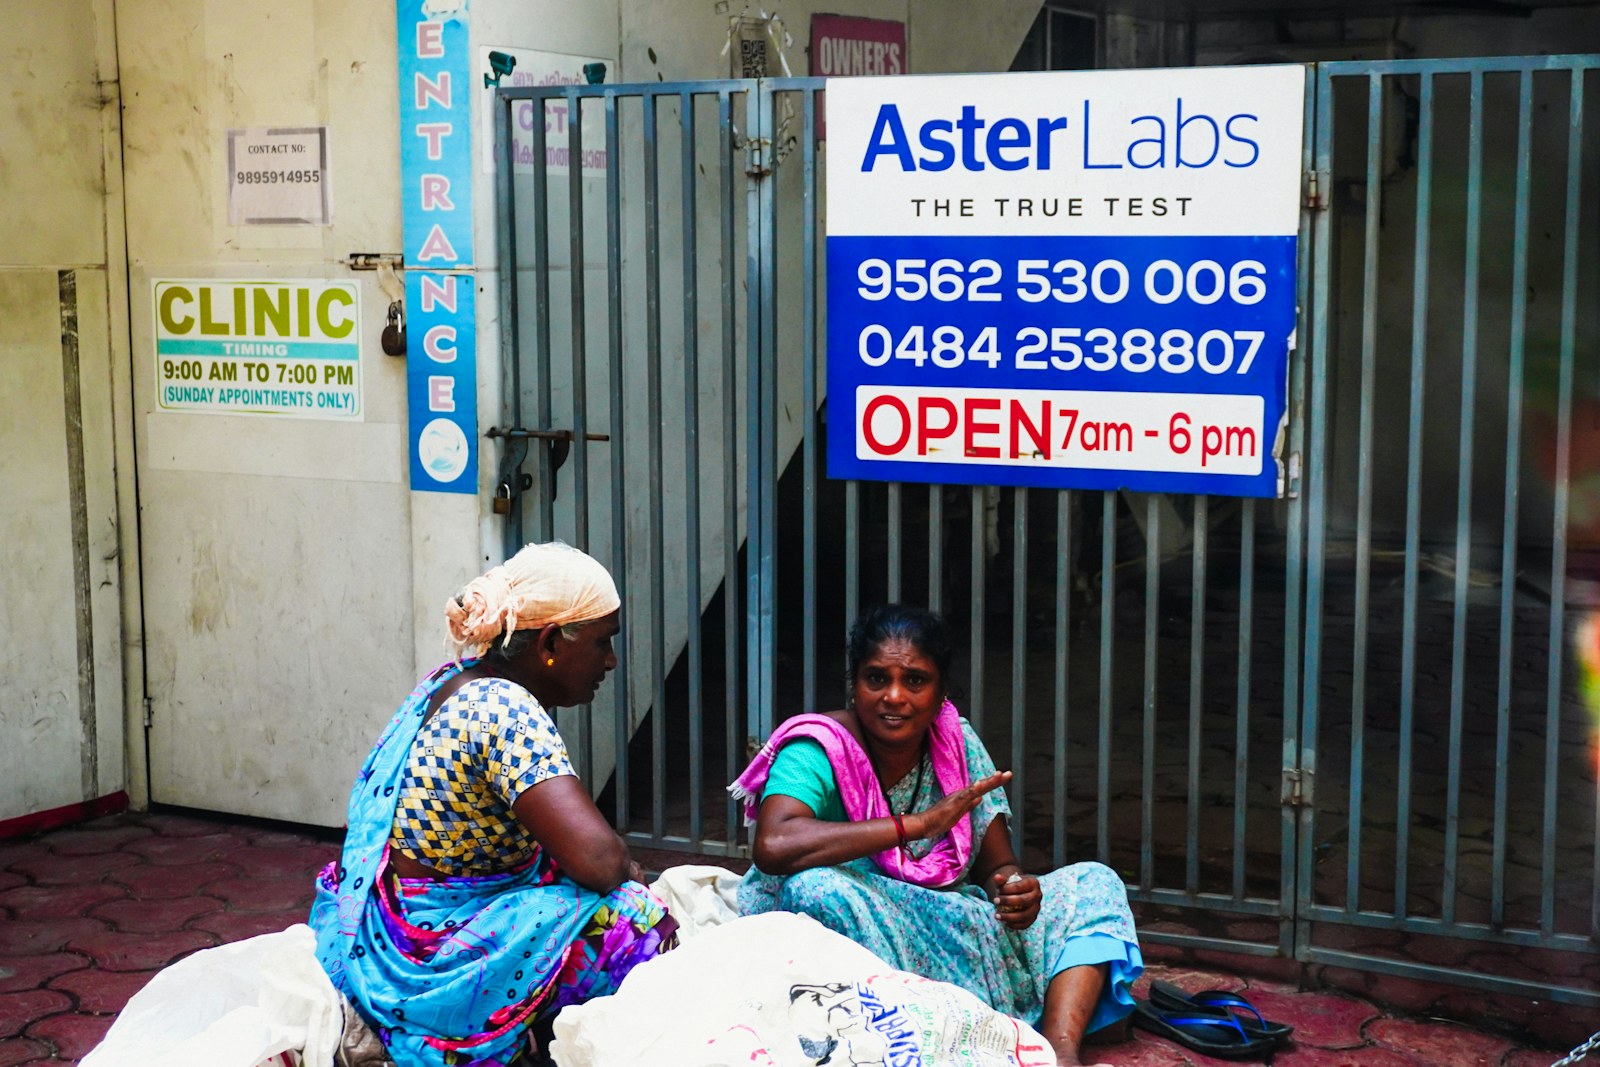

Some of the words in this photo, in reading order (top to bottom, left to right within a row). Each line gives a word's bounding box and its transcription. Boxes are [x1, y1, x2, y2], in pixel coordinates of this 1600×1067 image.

[820, 36, 901, 76] OWNER'S
[247, 144, 288, 154] CONTACT
[290, 145, 306, 153] NO:
[860, 103, 1067, 172] Aster
[1082, 97, 1260, 169] Labs
[237, 170, 320, 184] 9895914955
[415, 21, 457, 411] ENTRANCE
[911, 199, 974, 217] THE
[995, 198, 1083, 217] TRUE
[1104, 197, 1193, 216] TEST
[857, 258, 1002, 302] 9562
[1016, 259, 1129, 303] 530
[1144, 259, 1267, 305] 006
[159, 285, 355, 339] CLINIC
[222, 343, 288, 356] TIMING
[858, 324, 1002, 369] 0484
[1015, 327, 1266, 374] 2538807
[163, 361, 203, 380] 9:00
[208, 362, 238, 381] AM
[243, 363, 270, 382] TO
[276, 363, 318, 383] 7:00
[324, 364, 354, 385] PM
[163, 386, 215, 405] (SUNDAY
[218, 387, 313, 408] APPOINTMENTS
[317, 390, 355, 413] ONLY)
[862, 394, 1052, 461] OPEN
[1058, 409, 1133, 452] 7am
[1168, 412, 1191, 454] 6
[1201, 425, 1256, 466] pm
